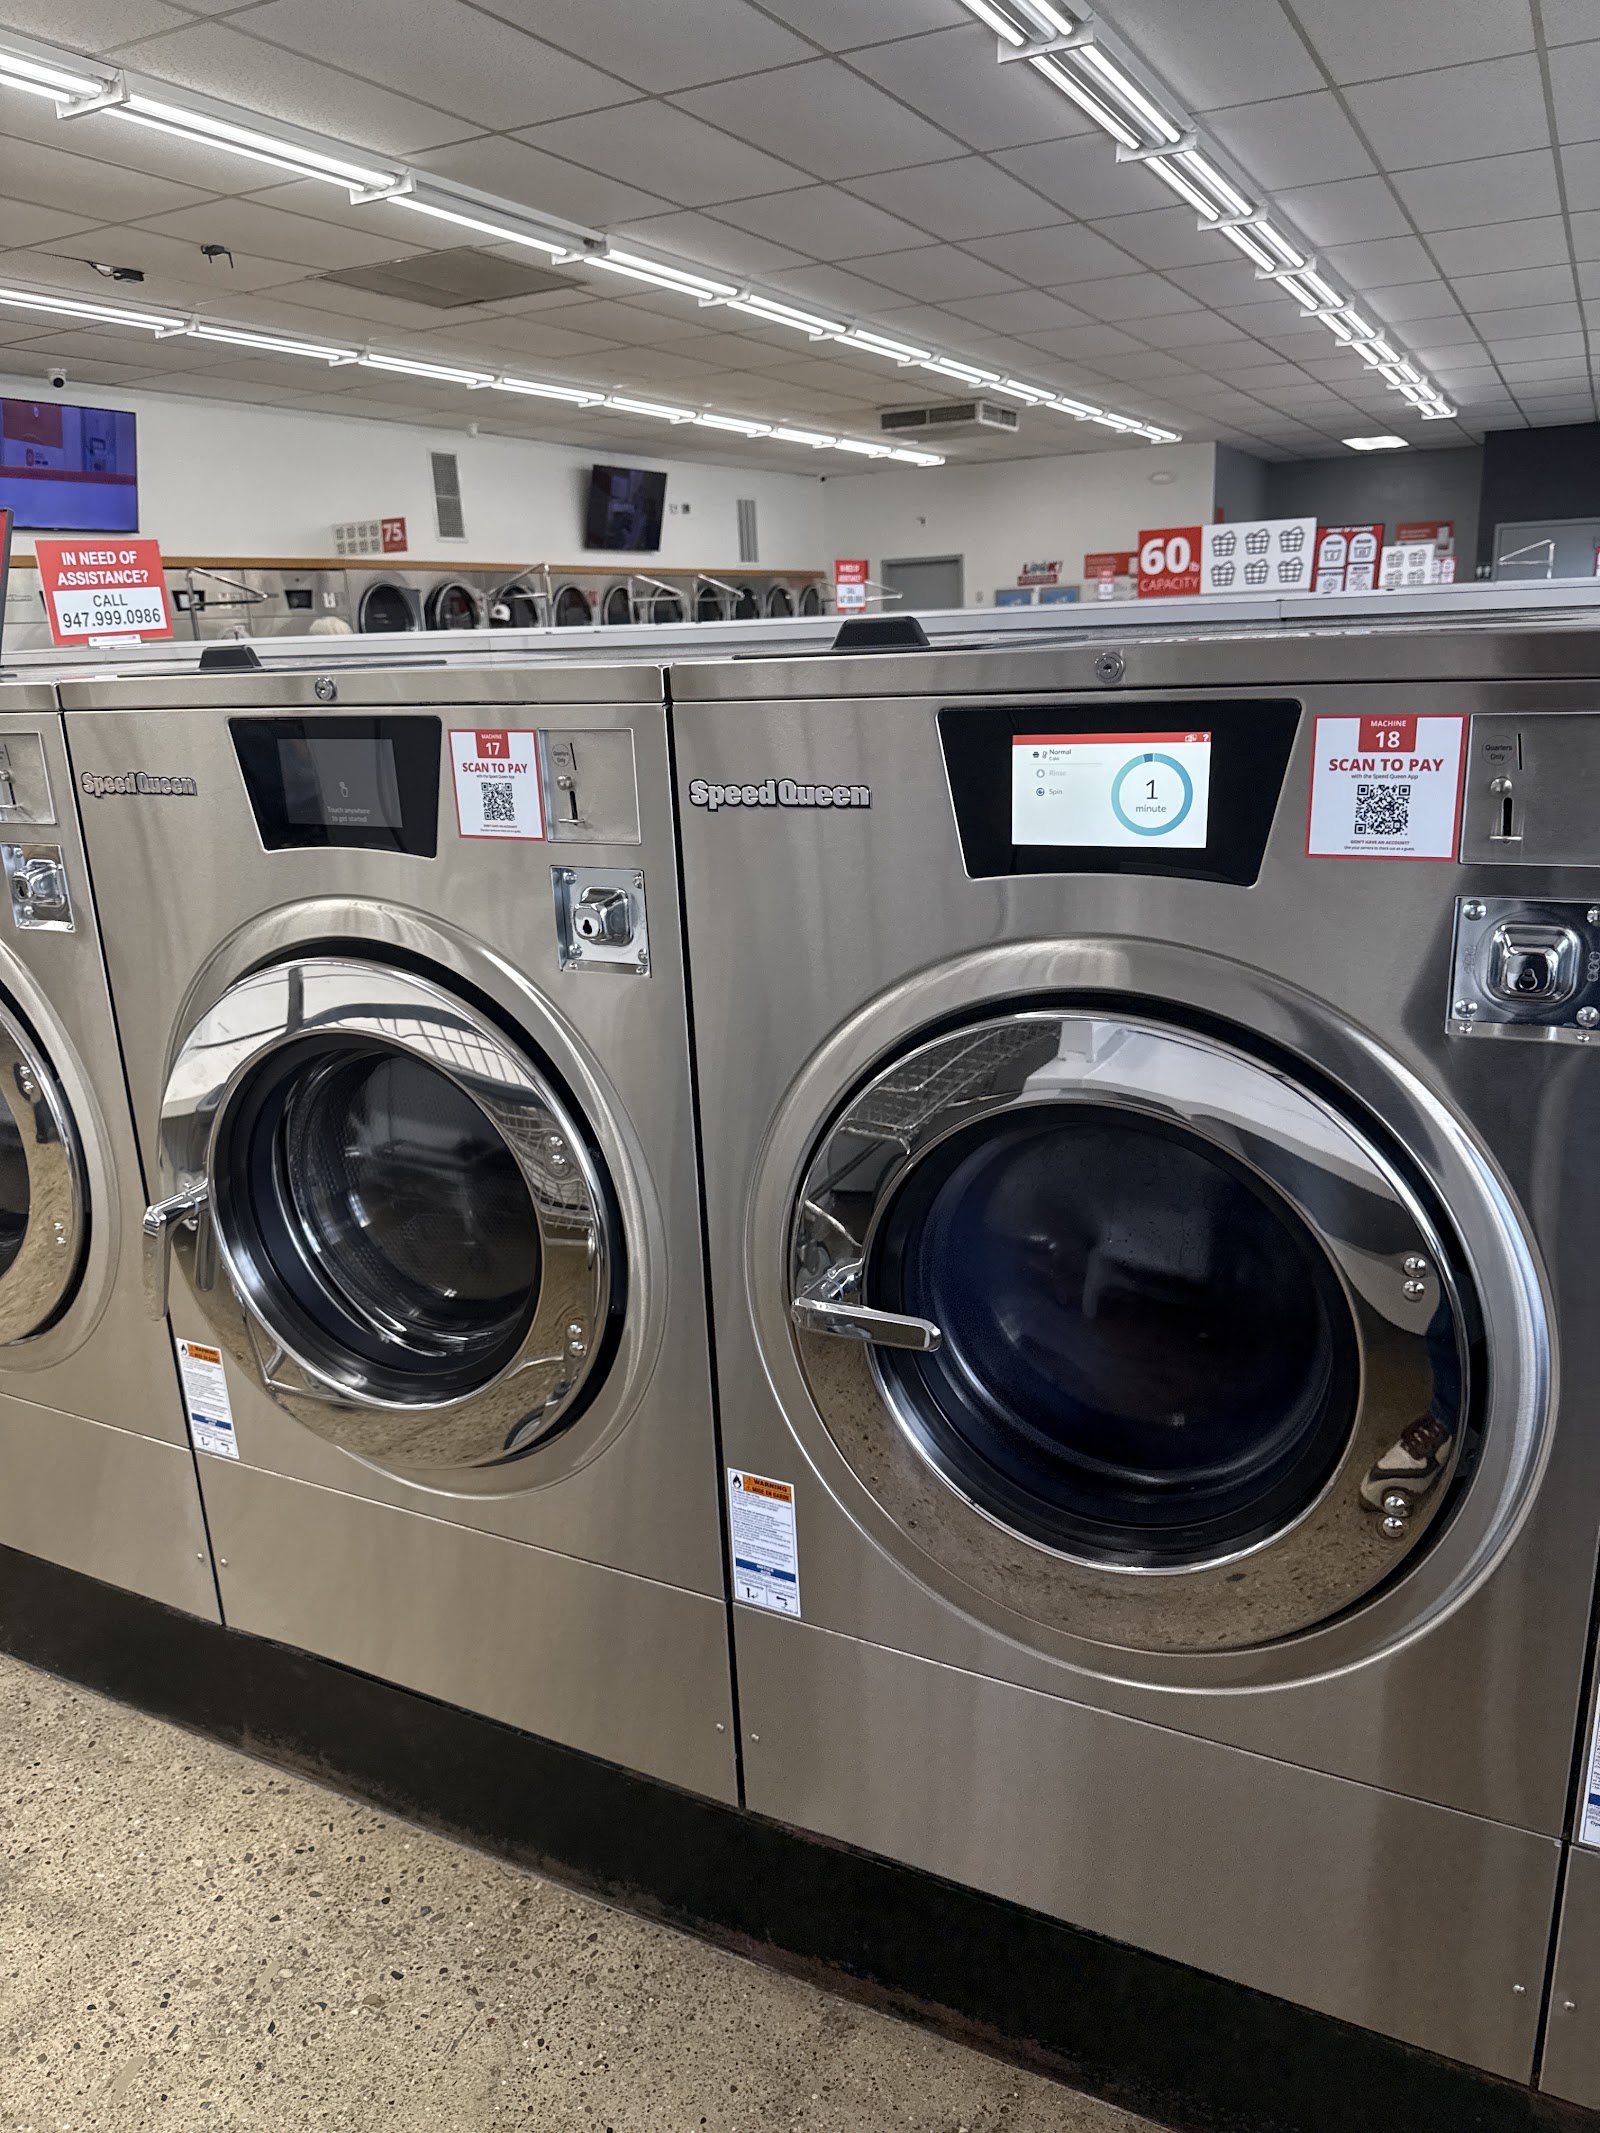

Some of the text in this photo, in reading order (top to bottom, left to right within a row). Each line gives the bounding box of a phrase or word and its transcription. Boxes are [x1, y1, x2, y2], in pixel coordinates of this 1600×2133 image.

[383, 522, 403, 541] 75
[61, 551, 137, 566] IN NEED OF
[1141, 537, 1190, 575] 60
[58, 570, 148, 586] ASSISTANCE?
[1140, 576, 1199, 592] CAPACITY
[93, 594, 128, 607] CALL
[63, 608, 160, 628] 947.999.0986
[1375, 731, 1400, 748] 18
[486, 742, 500, 755] 17
[1490, 753, 1505, 761] Only
[462, 763, 528, 773] SCAN TO PAY
[1329, 759, 1444, 772] SCAN TO PAY
[81, 772, 197, 798] Speed Queen
[1146, 779, 1158, 800] 1
[690, 778, 871, 811] Speed Queen
[1135, 804, 1167, 813] minute
[753, 1479, 787, 1492] WARNING
